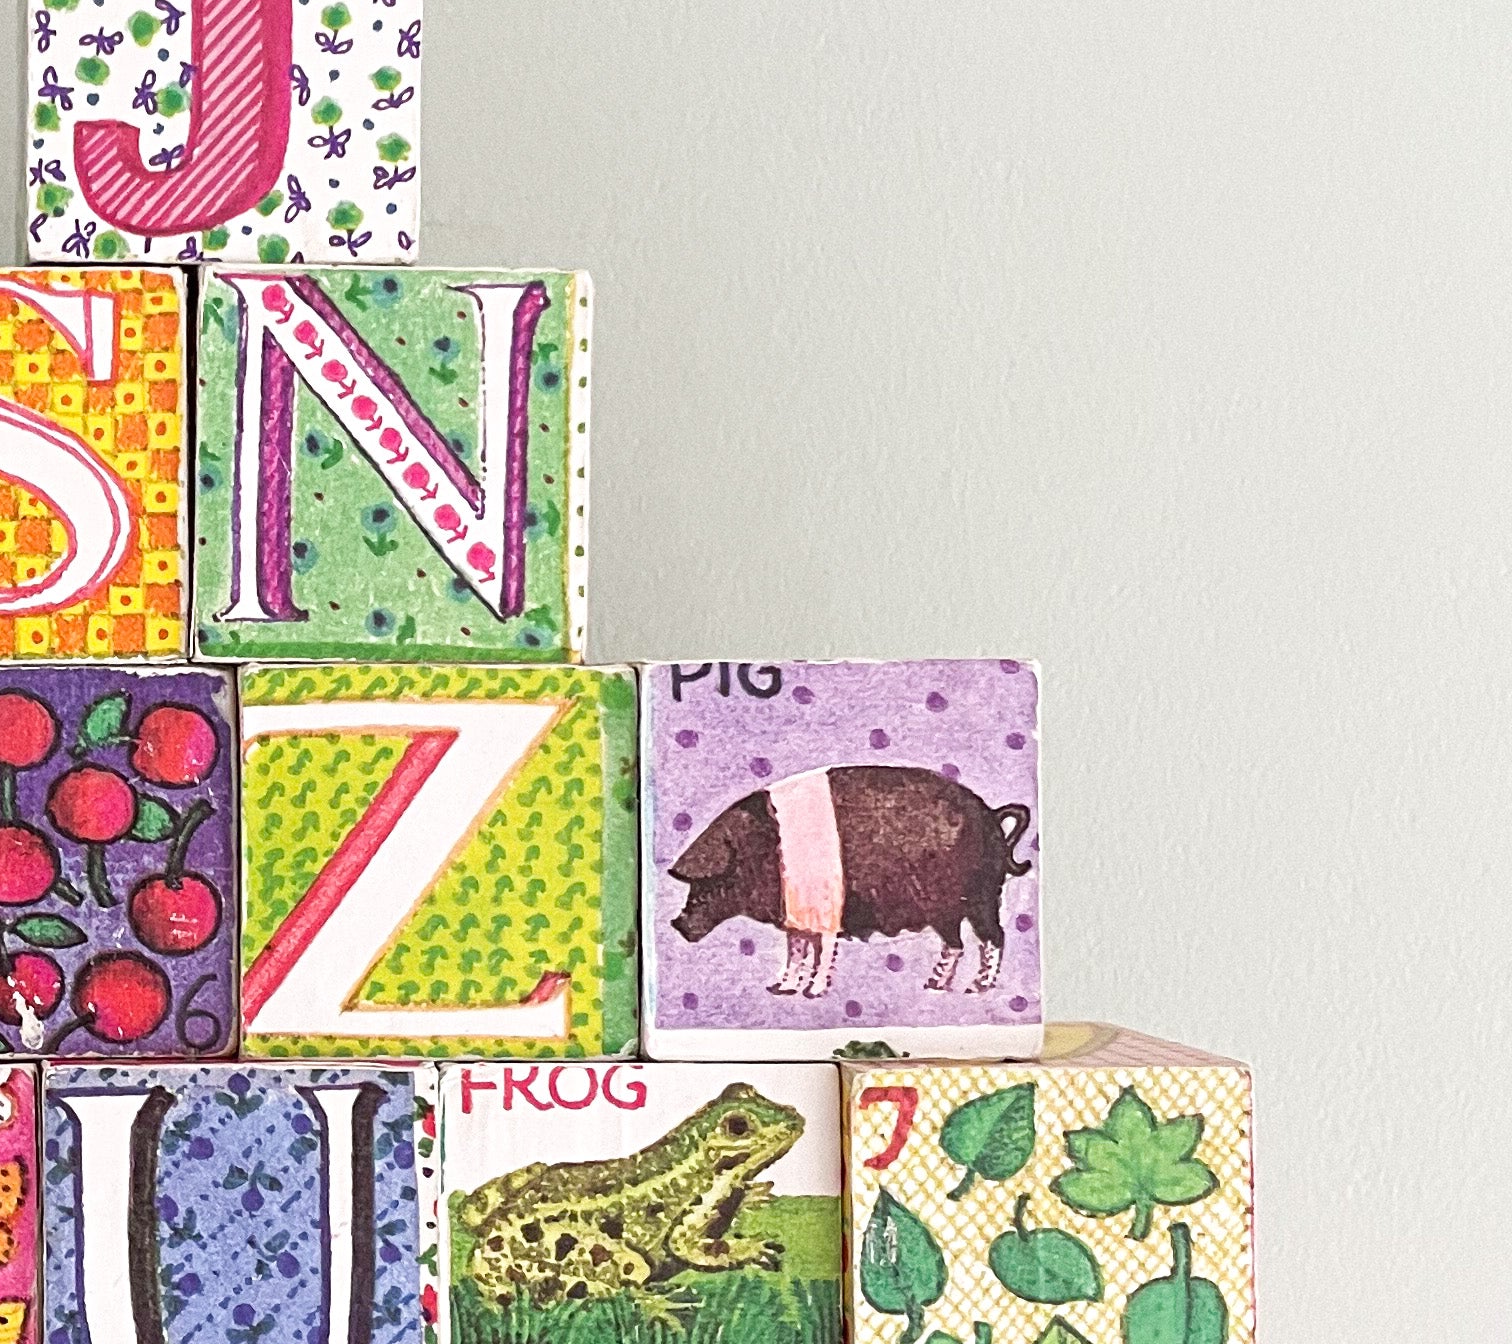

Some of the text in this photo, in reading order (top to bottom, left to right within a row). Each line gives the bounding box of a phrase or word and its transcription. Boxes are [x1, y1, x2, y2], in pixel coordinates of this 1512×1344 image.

[213, 272, 551, 624] N
[671, 662, 783, 702] PIG
[241, 697, 580, 1038] Z
[175, 973, 222, 1052] 6
[461, 1065, 647, 1114] FROG
[859, 1086, 919, 1170] 7
